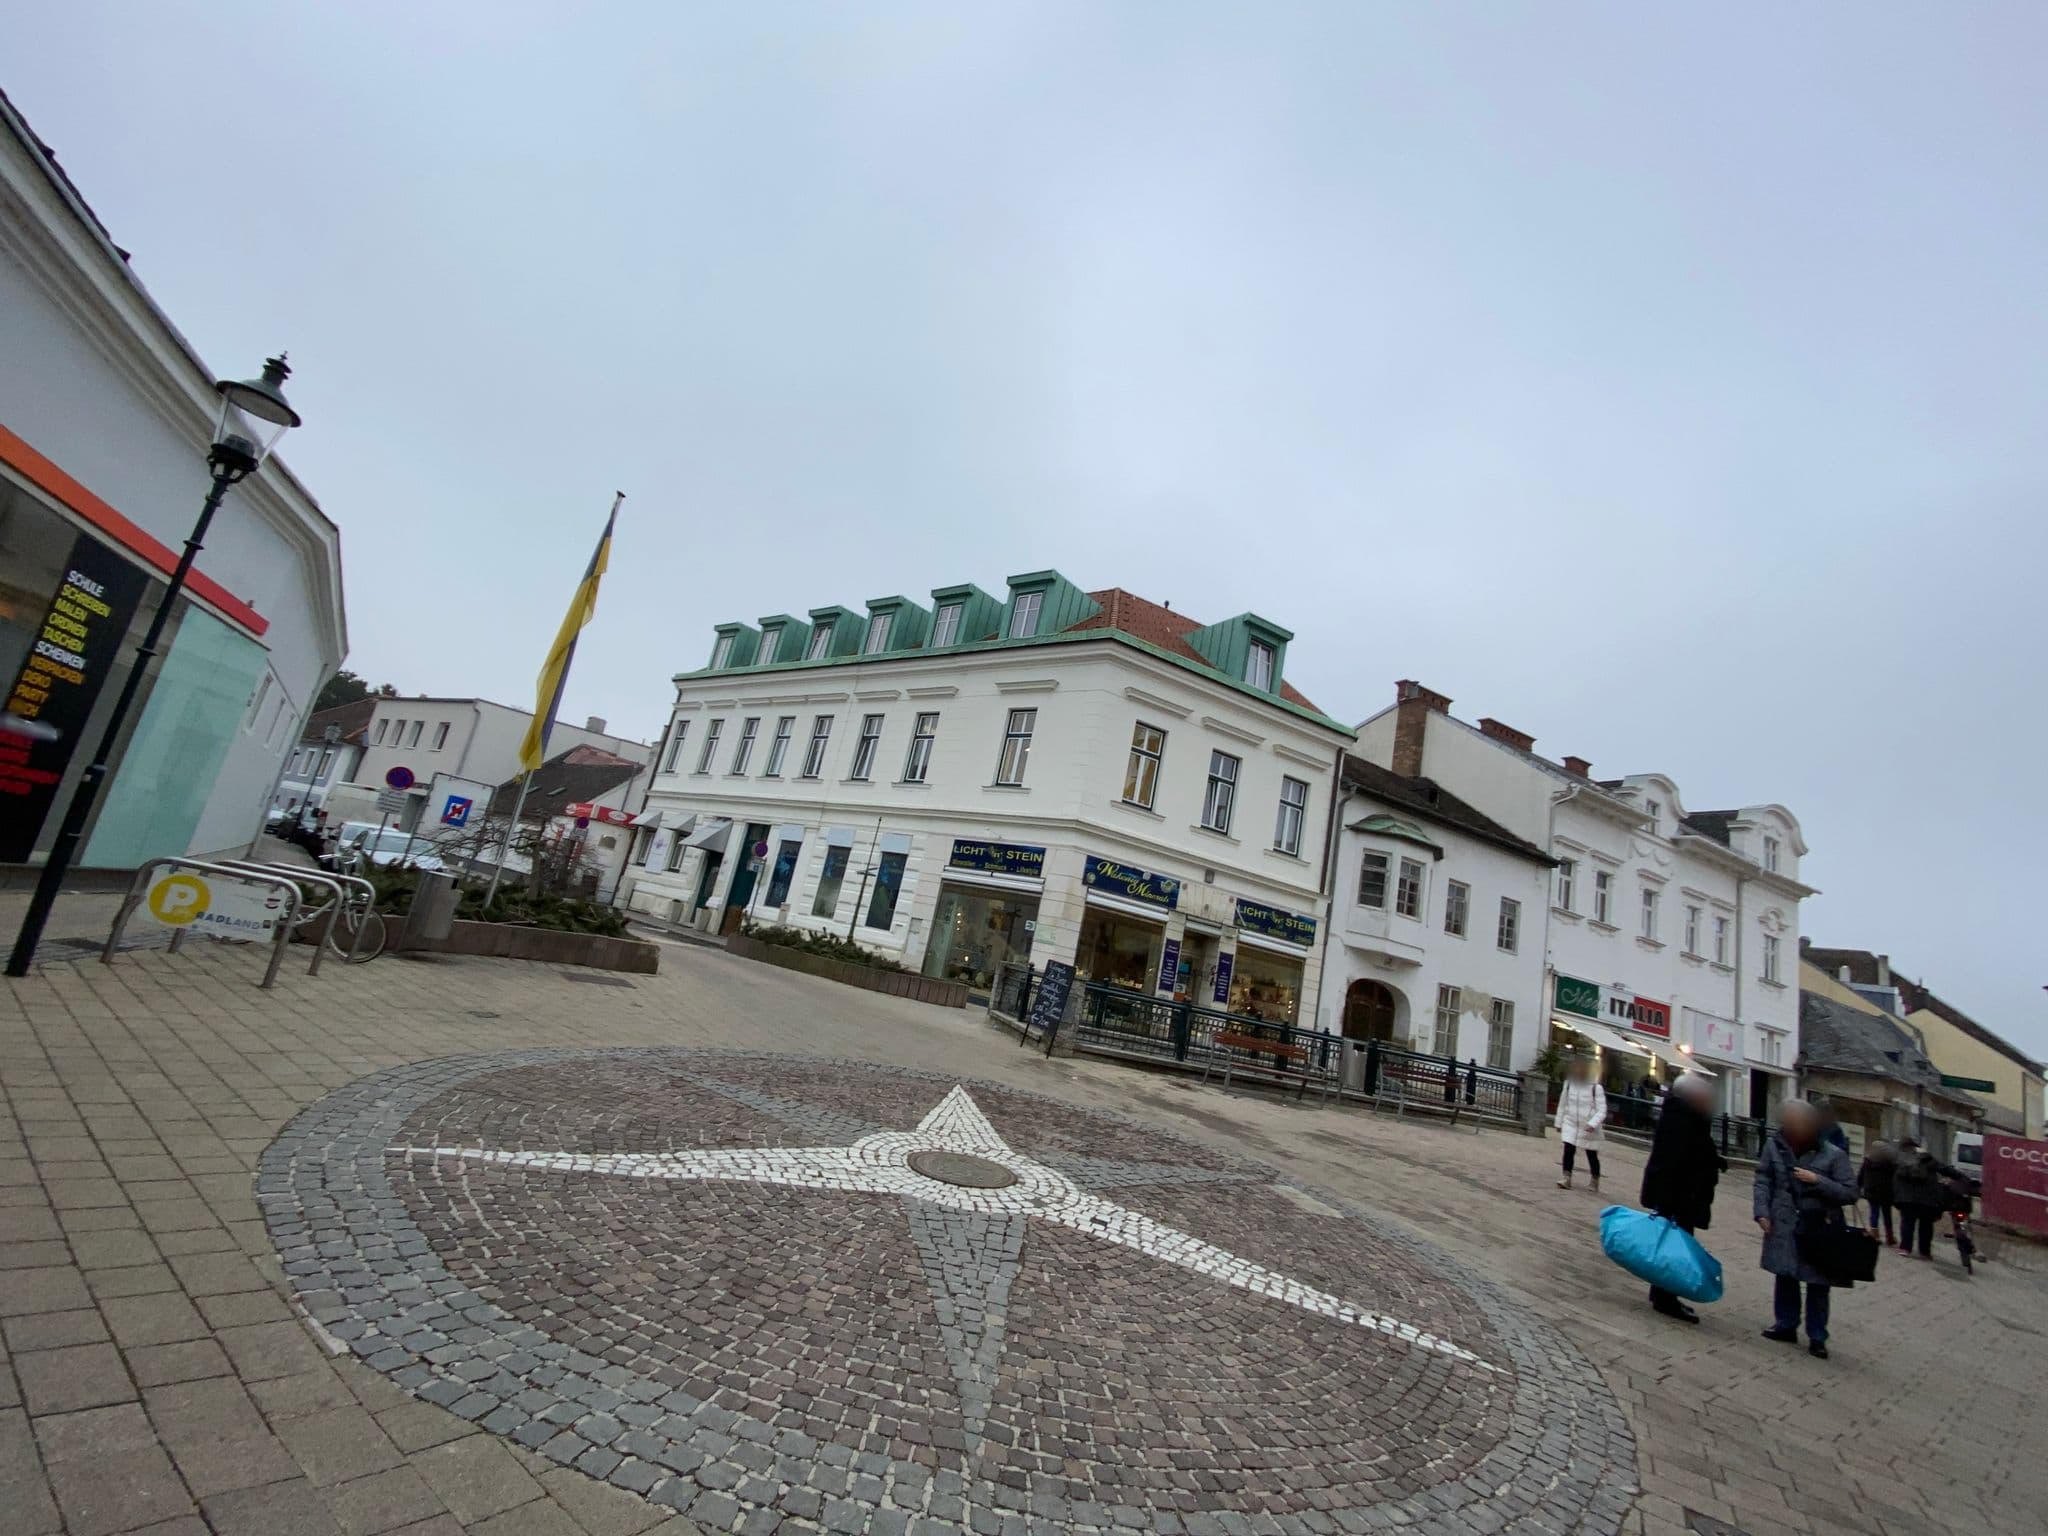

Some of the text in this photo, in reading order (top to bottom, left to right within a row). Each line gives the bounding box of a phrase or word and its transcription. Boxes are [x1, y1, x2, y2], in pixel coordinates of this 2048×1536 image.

[67, 570, 104, 598] SCHULE
[55, 597, 88, 622] MALEN
[61, 584, 111, 618] SCHREIBEN
[42, 625, 85, 653] TASCHEN
[48, 612, 88, 638] ORDNEN
[35, 640, 87, 670] SCHENKEN
[953, 844, 987, 857] LICHT
[1006, 850, 1043, 863] STEIN
[161, 882, 199, 915] P
[1238, 905, 1268, 920] LICHT
[1284, 917, 1315, 934] STEIN
[1608, 996, 1666, 1029] ITALIA
